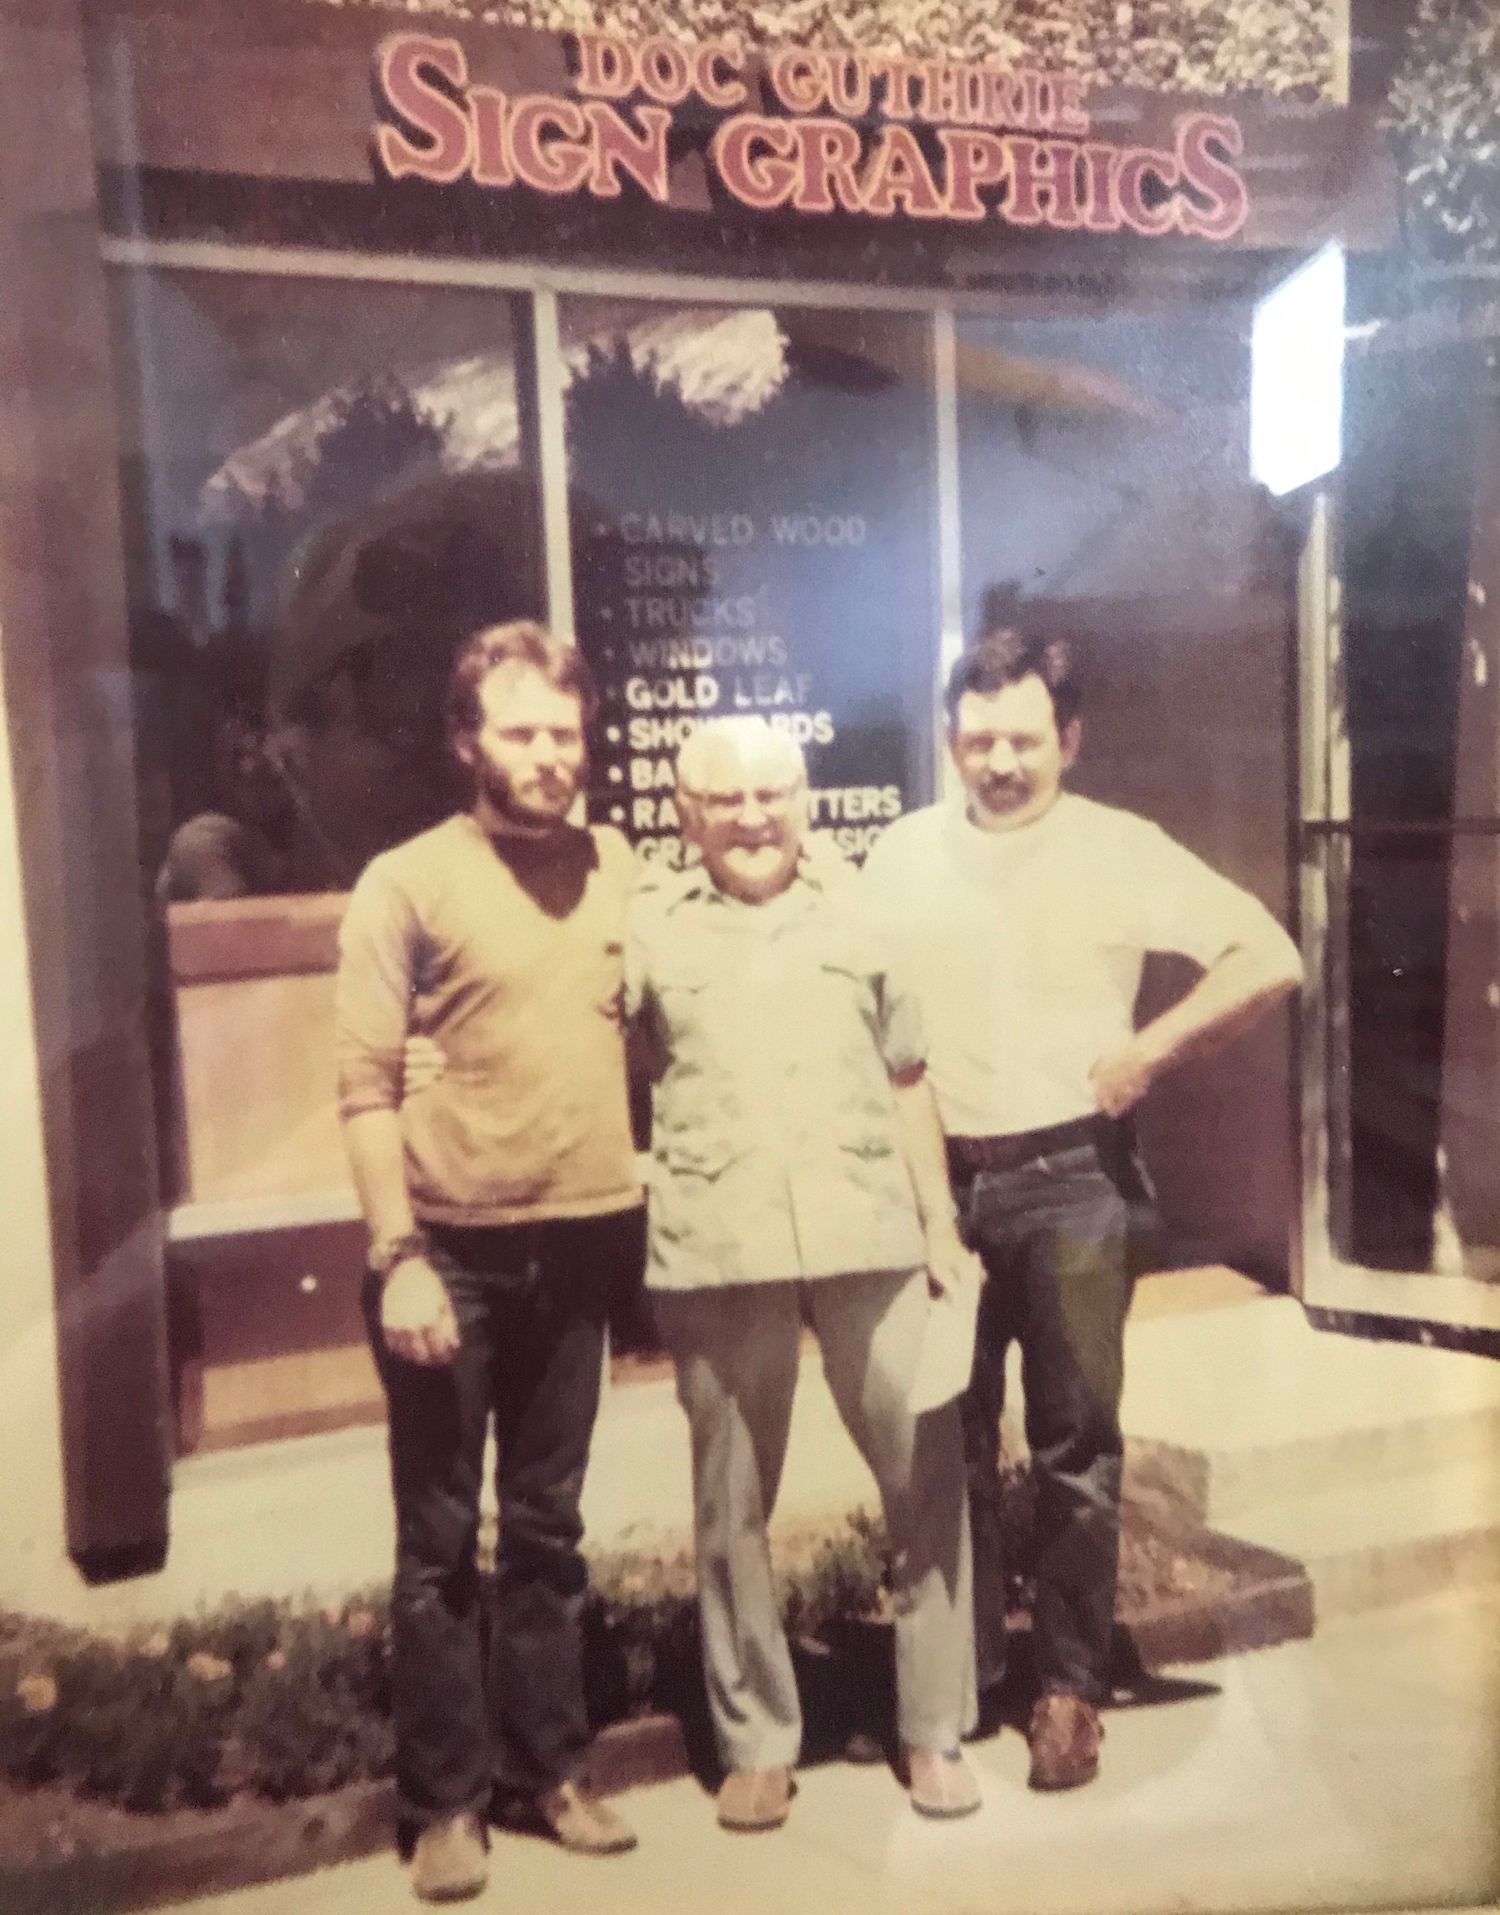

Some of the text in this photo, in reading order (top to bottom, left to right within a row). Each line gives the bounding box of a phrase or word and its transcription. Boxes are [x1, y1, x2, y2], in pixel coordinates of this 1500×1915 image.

[577, 33, 1090, 134] DOC GUTHRIE
[375, 33, 1248, 239] SIGN GRAPHICS
[620, 512, 866, 547] CARVED WOOD
[624, 555, 718, 587] SIGNS
[626, 597, 756, 627] TRUCKS
[629, 635, 788, 669] WINDOWS
[625, 672, 812, 709] GOLD LEAF
